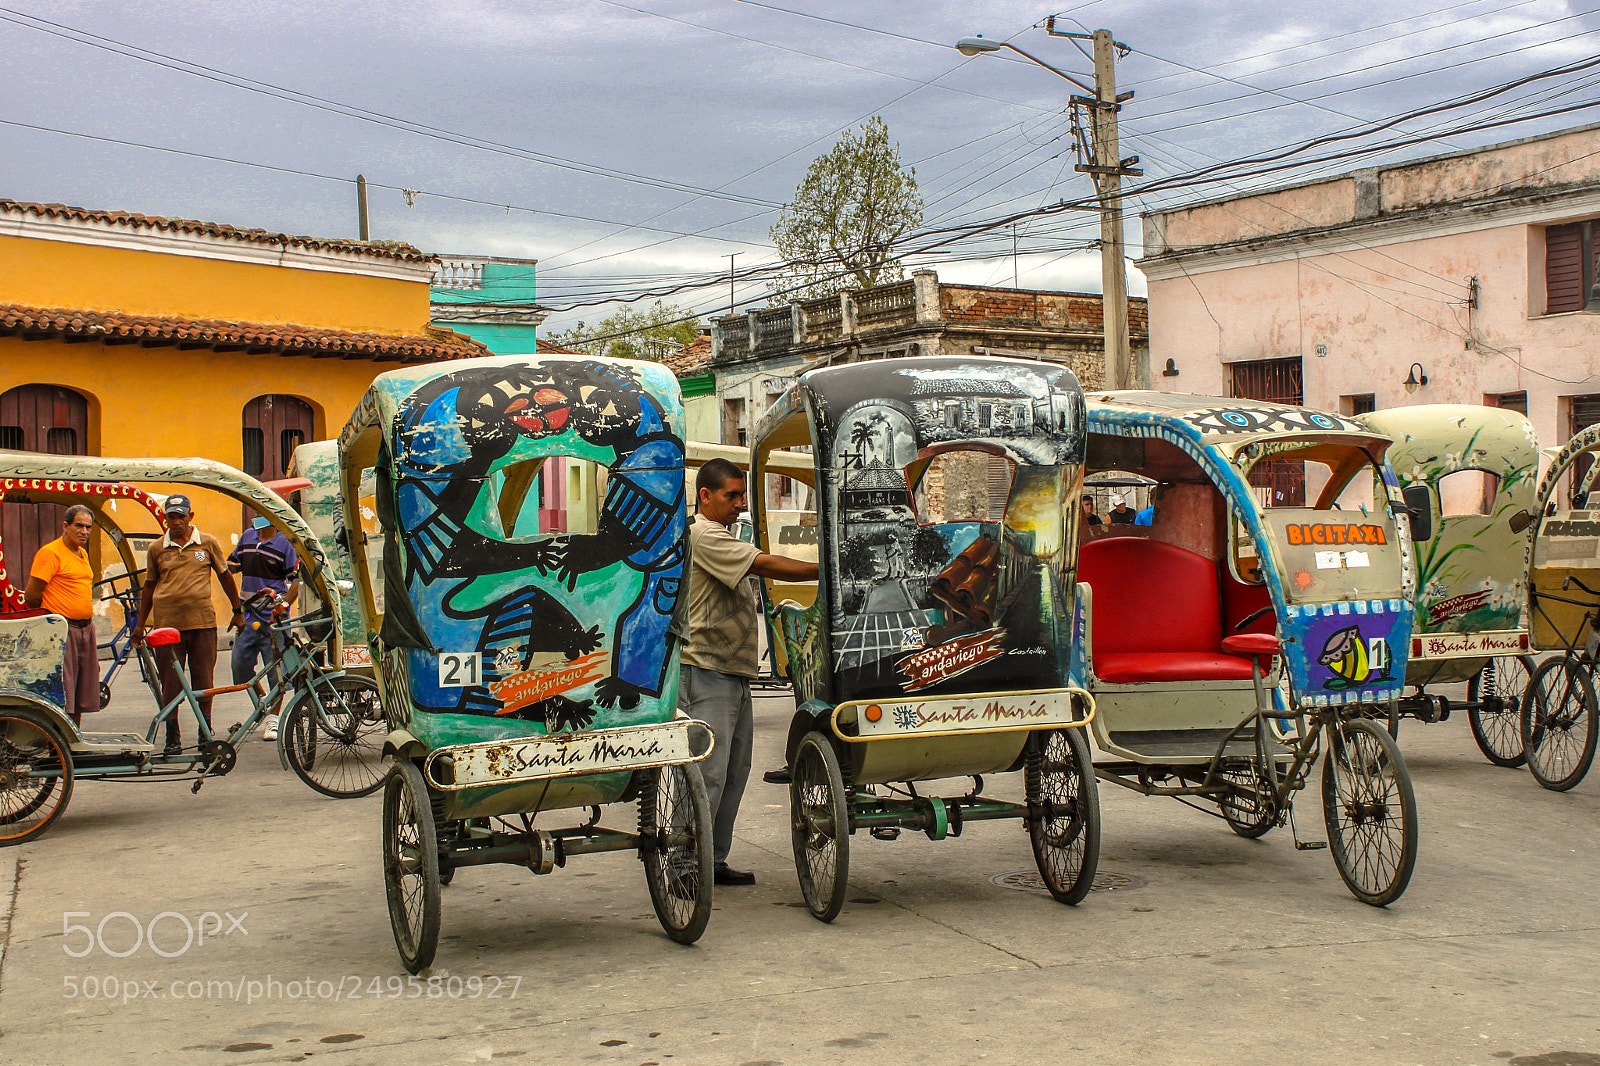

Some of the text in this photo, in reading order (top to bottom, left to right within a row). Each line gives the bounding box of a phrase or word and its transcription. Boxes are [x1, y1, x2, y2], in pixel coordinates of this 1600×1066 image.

[1286, 523, 1387, 545] BICITAXI
[1372, 640, 1382, 667] 1
[1439, 636, 1519, 655] Santa María
[443, 654, 477, 685] 21
[921, 644, 984, 678] andariego
[514, 668, 583, 701] andariego
[916, 699, 1049, 728] Santa María
[516, 738, 663, 772] Santa María
